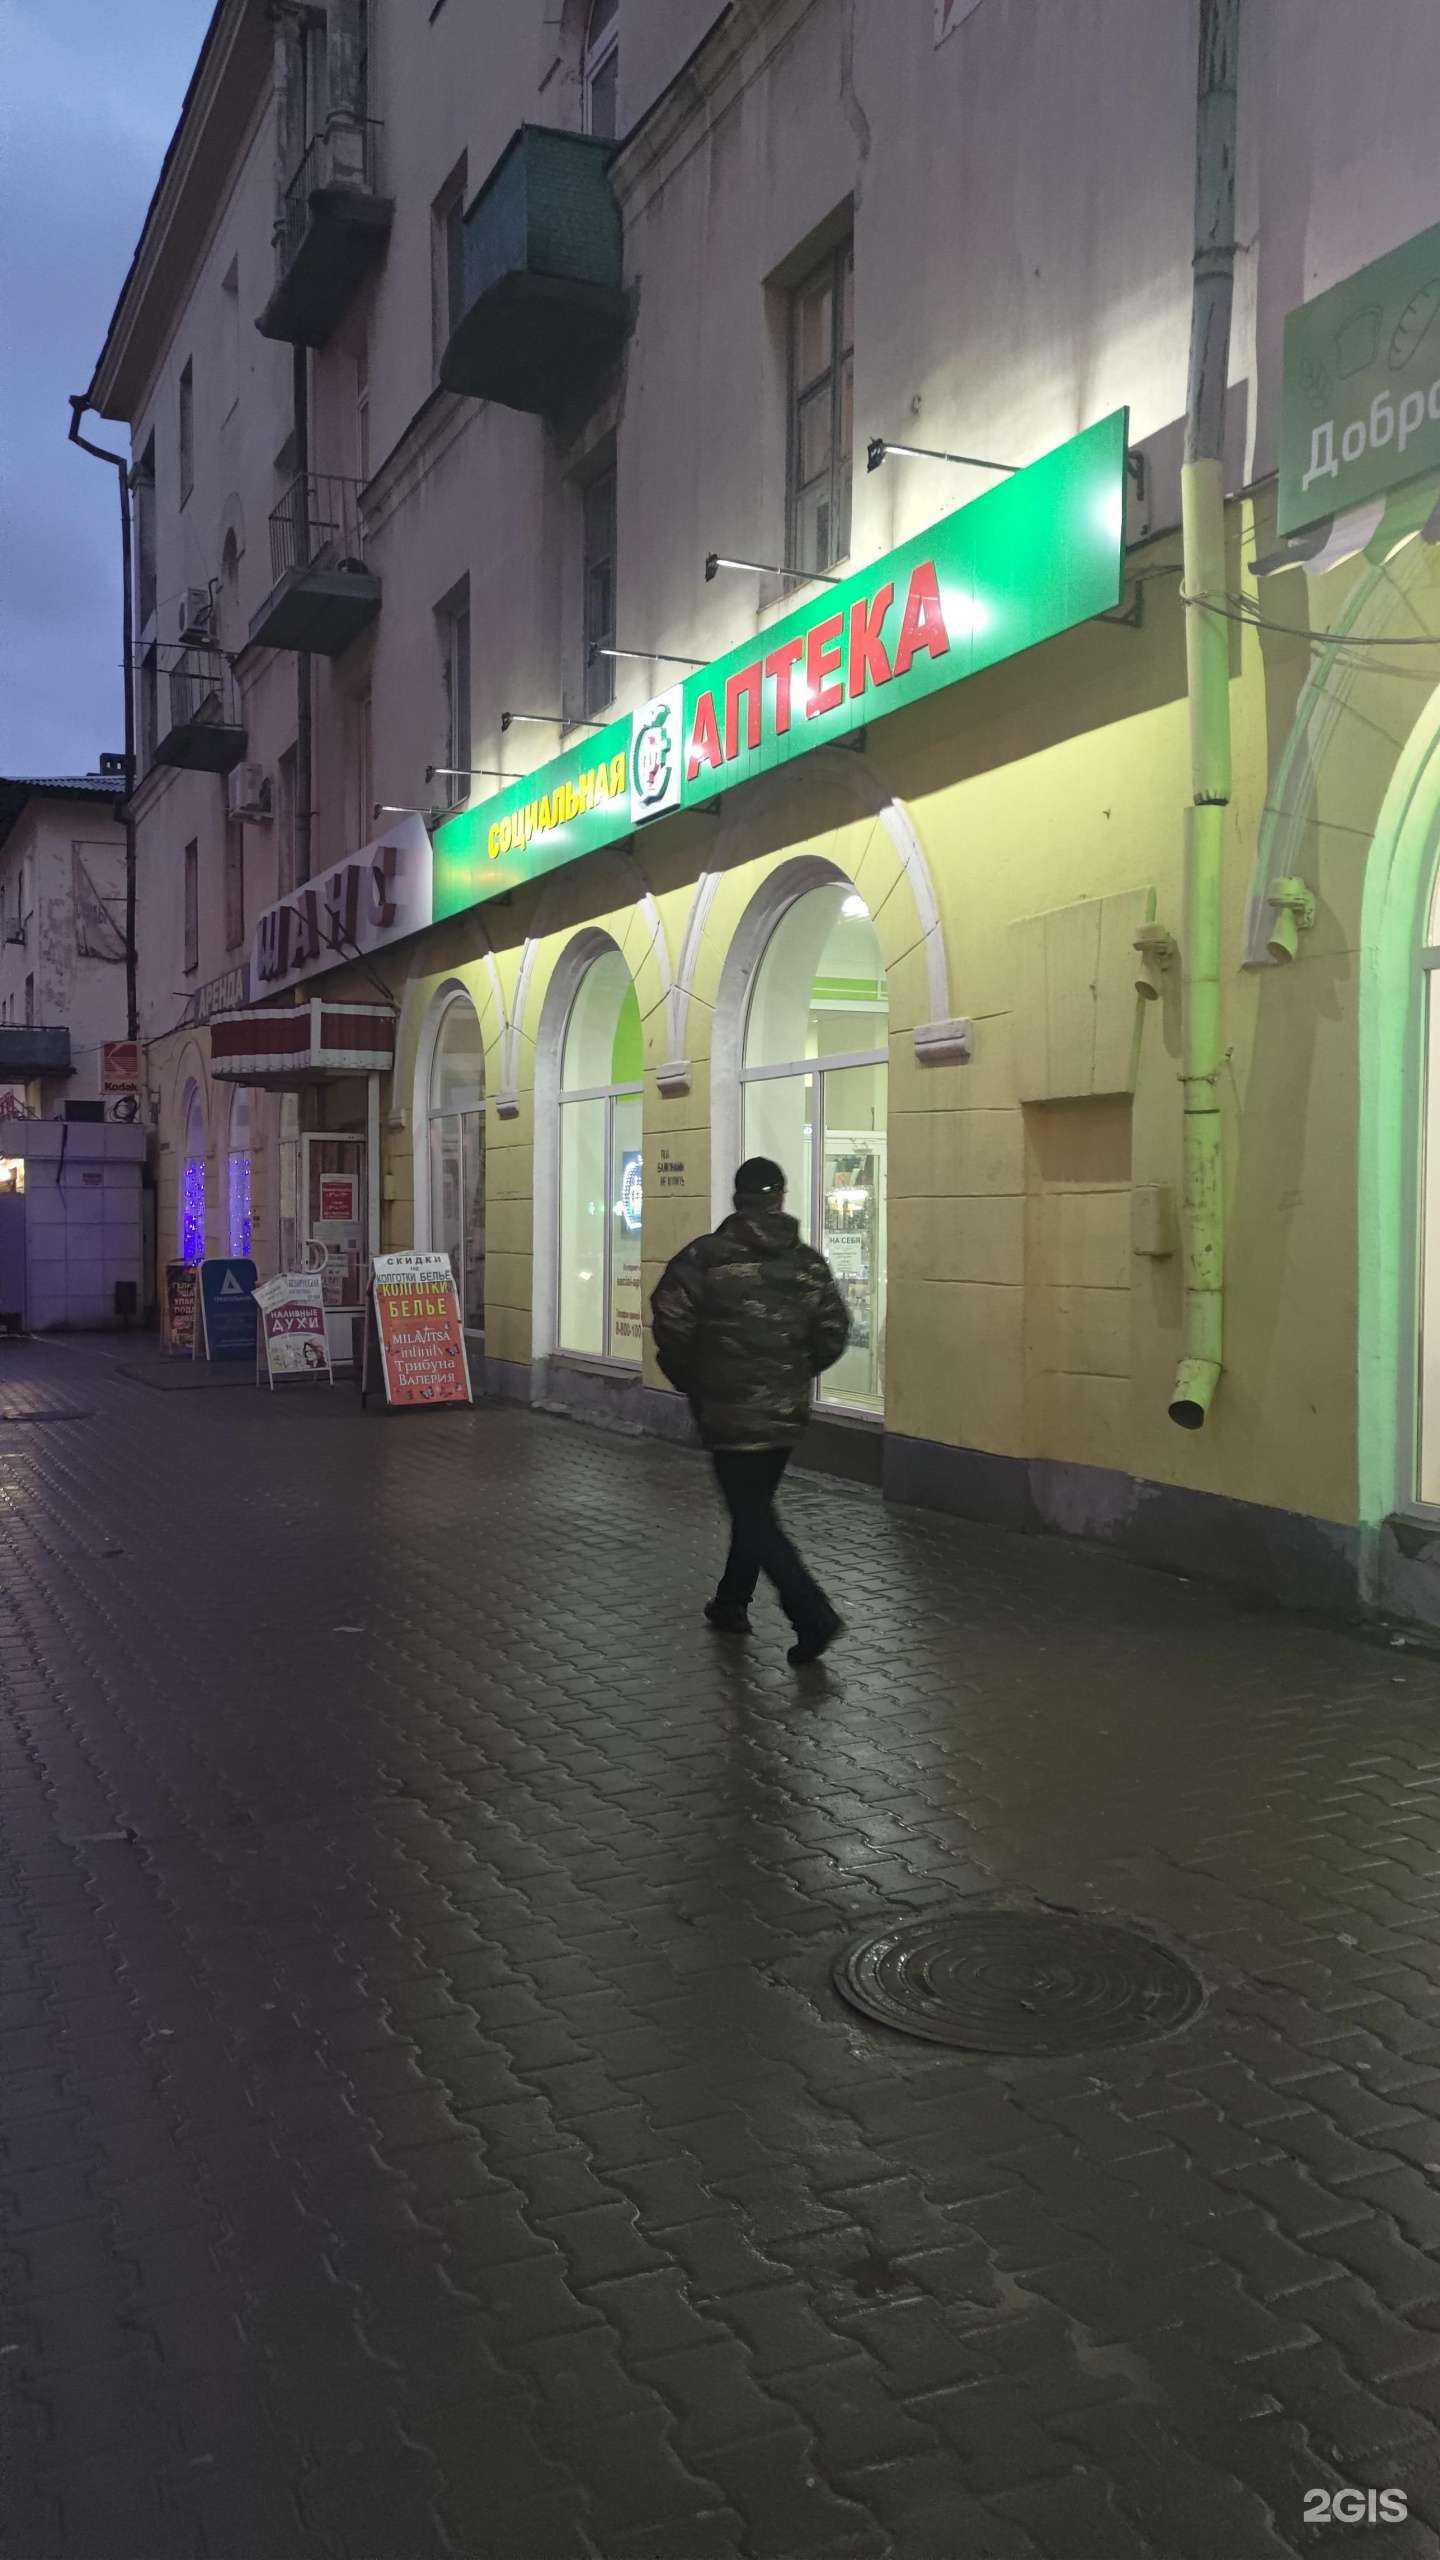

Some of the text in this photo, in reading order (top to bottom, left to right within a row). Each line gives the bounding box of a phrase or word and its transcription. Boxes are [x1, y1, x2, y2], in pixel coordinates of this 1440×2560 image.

[487, 559, 951, 859] СОЦИАЛЬНАЯ АПТЕКА
[104, 1082, 137, 1091] Kodak
[386, 1256, 442, 1266] СКИДКИ
[377, 1272, 416, 1284] КОЛГОТКИ
[382, 1282, 449, 1297] КОЛГОТКИ
[271, 1309, 318, 1319] НАЛИВНЫЕ
[389, 1298, 447, 1318] БЕЛЬЕ
[272, 1318, 319, 1333] ДУХИ
[392, 1327, 451, 1345] MILAVITSA
[394, 1359, 455, 1374] Трибуна
